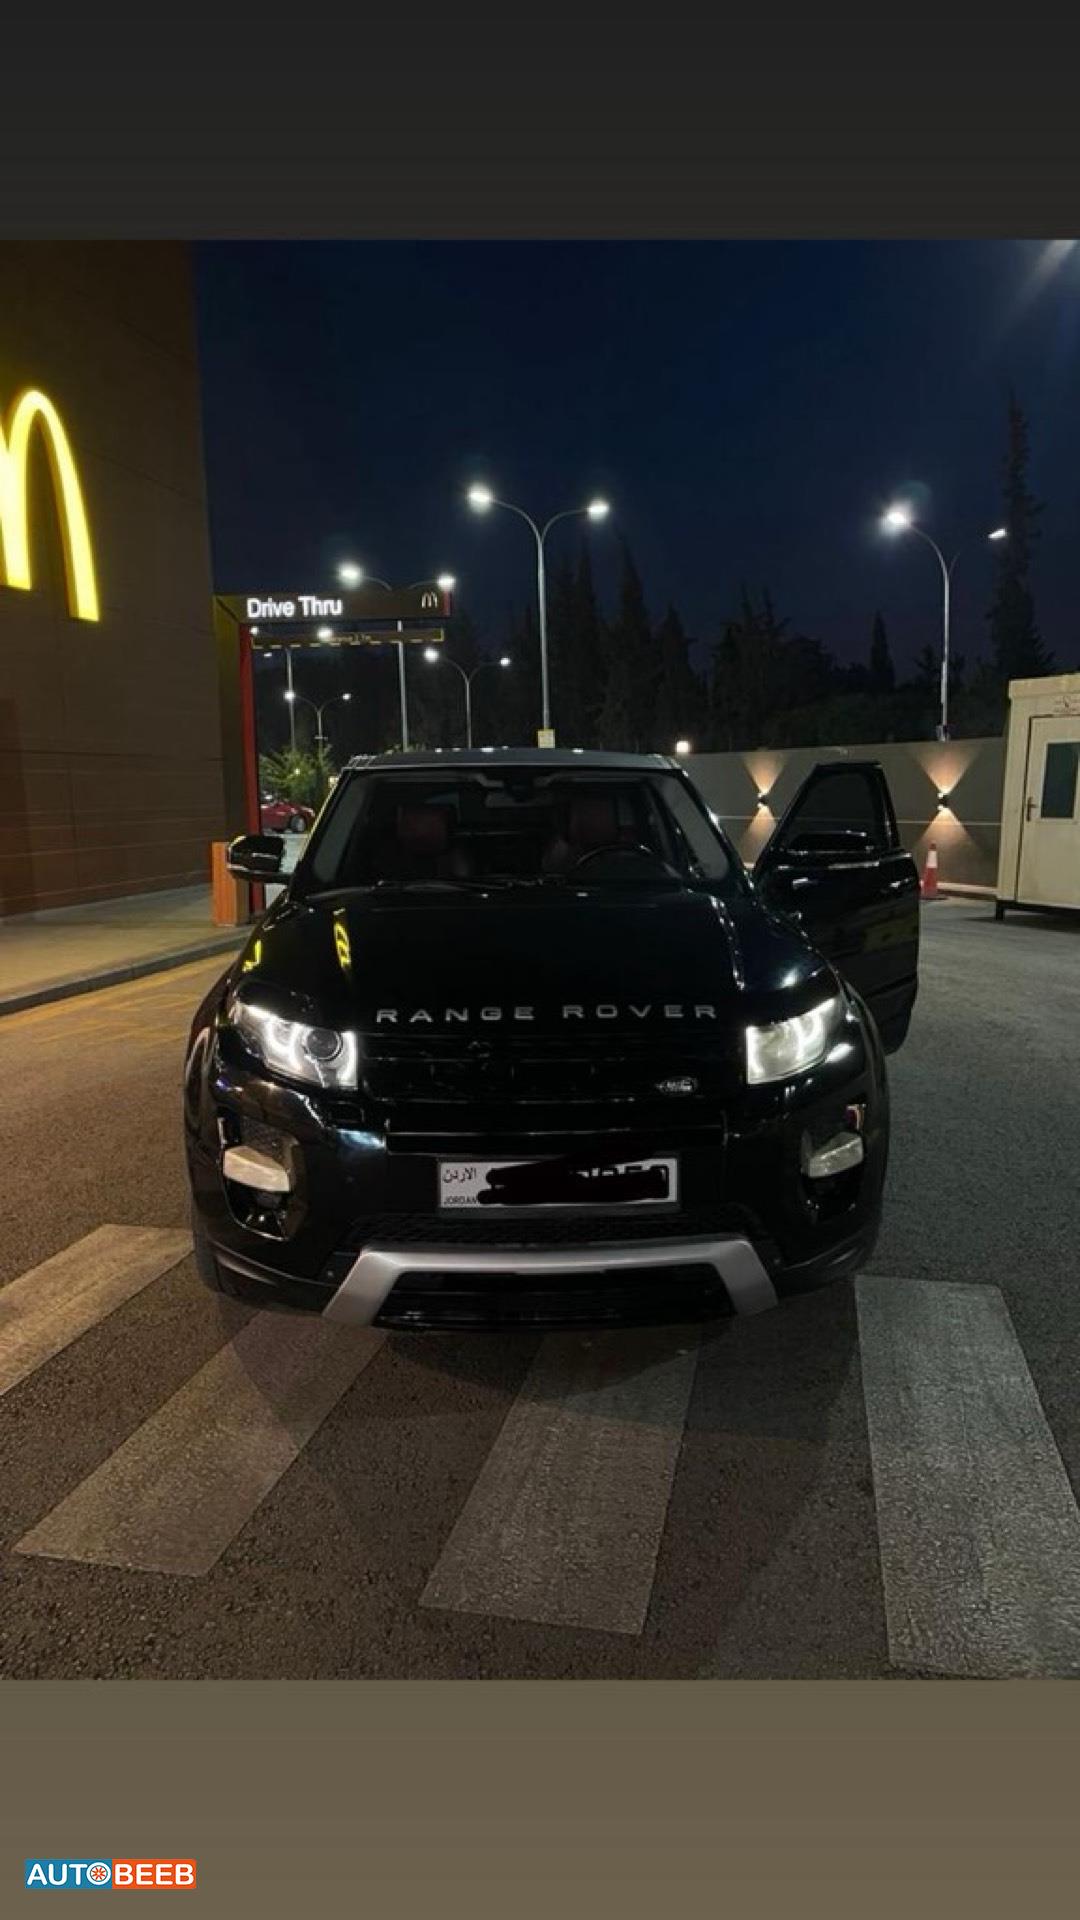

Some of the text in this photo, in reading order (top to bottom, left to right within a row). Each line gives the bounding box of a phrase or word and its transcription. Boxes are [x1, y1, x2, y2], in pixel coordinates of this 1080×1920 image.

[247, 595, 343, 618] Drive Thru
[376, 1004, 717, 1023] RANGE ROVER
